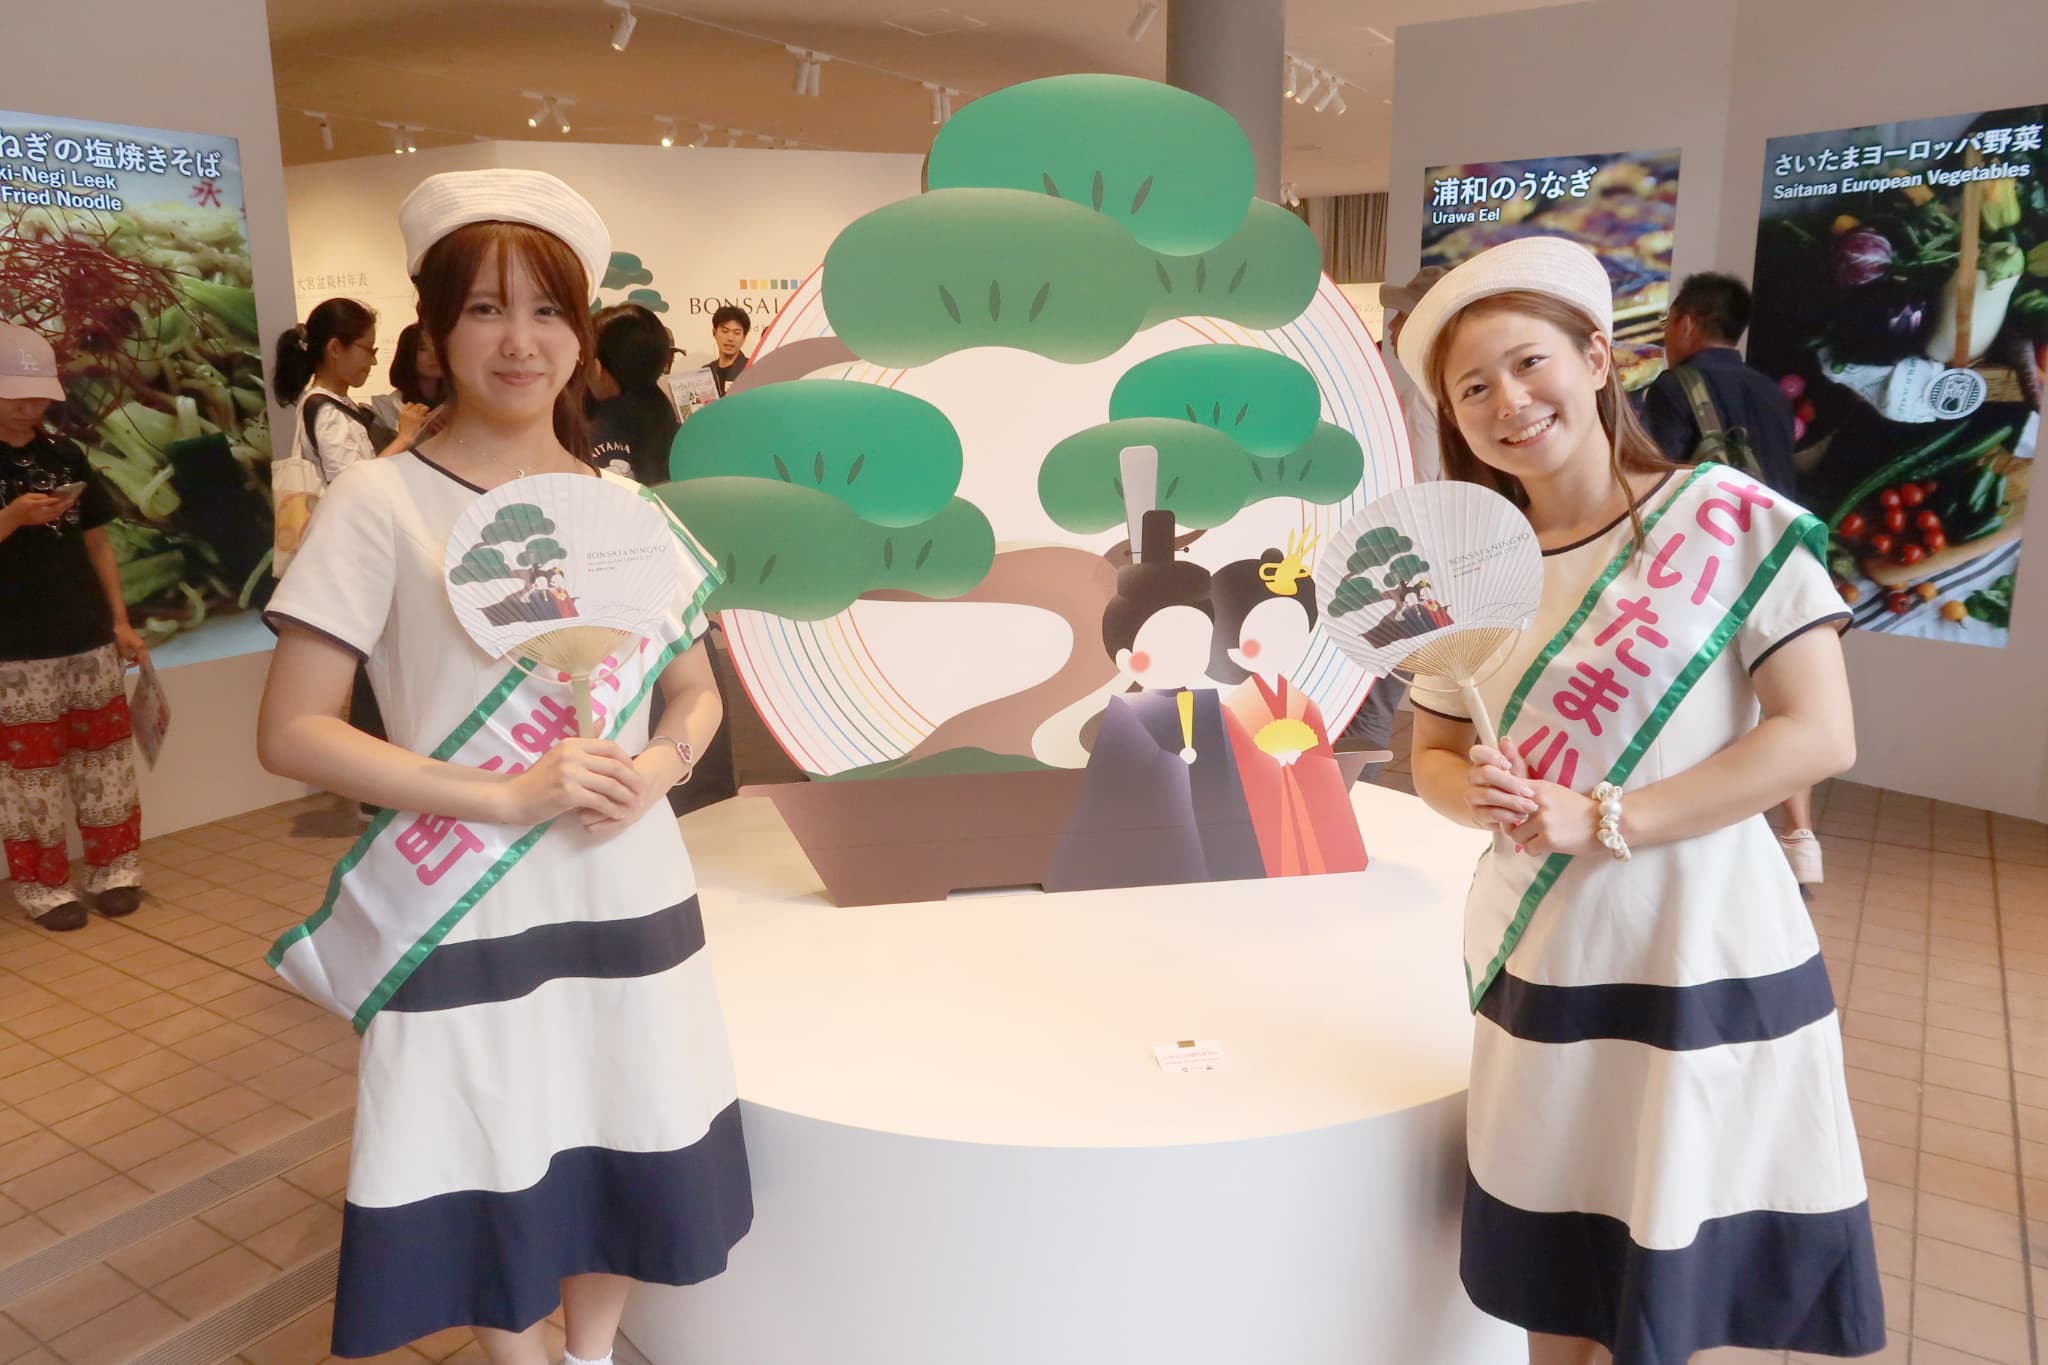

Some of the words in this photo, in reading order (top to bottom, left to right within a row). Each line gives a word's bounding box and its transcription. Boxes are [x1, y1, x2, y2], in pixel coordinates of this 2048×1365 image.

[1774, 123, 2044, 177] さいたまヨーロッパ野菜
[72, 169, 117, 190] Leek
[1432, 166, 1598, 207] 浦和のうなぎ
[1773, 182, 1837, 200] Saitama
[1841, 172, 1922, 193] European
[1927, 161, 2031, 188] Vegetables
[1, 185, 51, 205] Fried
[56, 190, 122, 211] Noodle
[1432, 210, 1475, 225] Urawa
[1479, 207, 1500, 222] Eel
[689, 297, 779, 315] BONSAI
